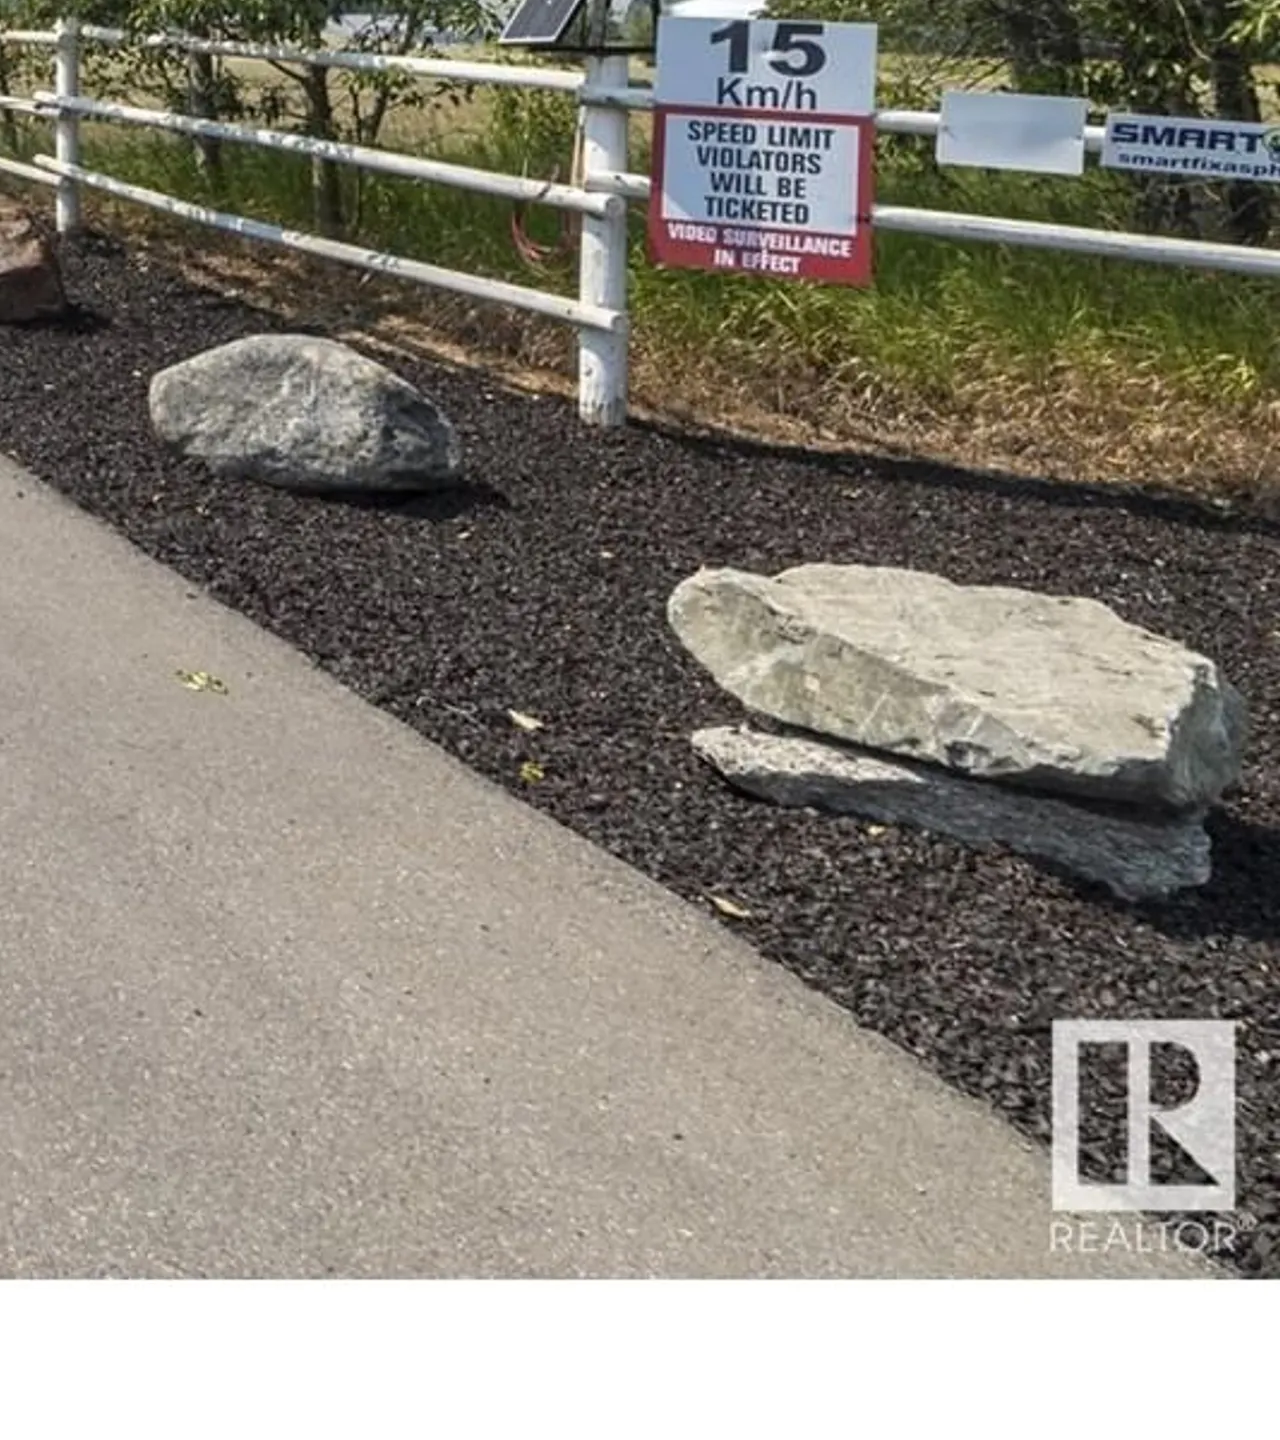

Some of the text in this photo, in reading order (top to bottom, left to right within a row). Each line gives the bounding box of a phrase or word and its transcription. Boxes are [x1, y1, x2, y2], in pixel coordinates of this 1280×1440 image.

[710, 20, 826, 77] 15
[717, 77, 817, 110] Km/h
[688, 121, 835, 150] SPEED LIMIT
[1111, 123, 1263, 153] SMART
[697, 145, 821, 174] VIOLATORS
[711, 172, 807, 199] WILL BE
[704, 196, 809, 225] TICKETED
[668, 223, 853, 258] VIDEO SURVEILLANCE
[714, 249, 801, 273] IN EFFECT
